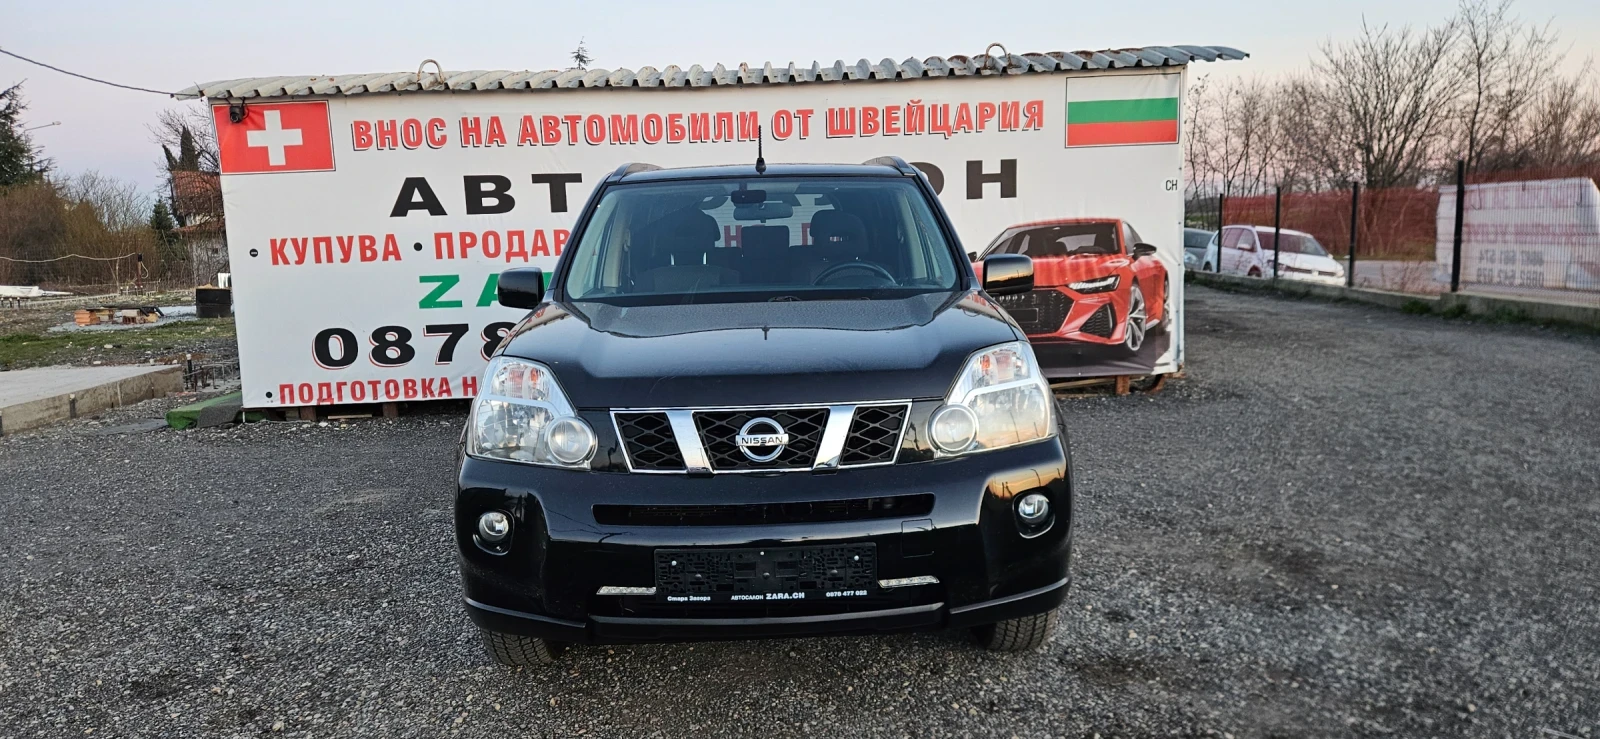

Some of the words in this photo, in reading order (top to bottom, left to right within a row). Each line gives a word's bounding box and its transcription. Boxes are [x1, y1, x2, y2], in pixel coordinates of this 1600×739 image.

[350, 117, 448, 151] ВНОС
[459, 115, 507, 147] НА
[517, 111, 760, 146] АВТОМОБИЛИ
[770, 108, 815, 140] ОТ
[825, 99, 1045, 140] ШВЕЙЦАРИЯ
[1165, 179, 1178, 191] CH
[269, 233, 402, 266] КУПУВА
[279, 377, 452, 405] ПОДГОТОВКА
[741, 436, 783, 445] NISSAN
[765, 591, 805, 600] ZARA.CH
